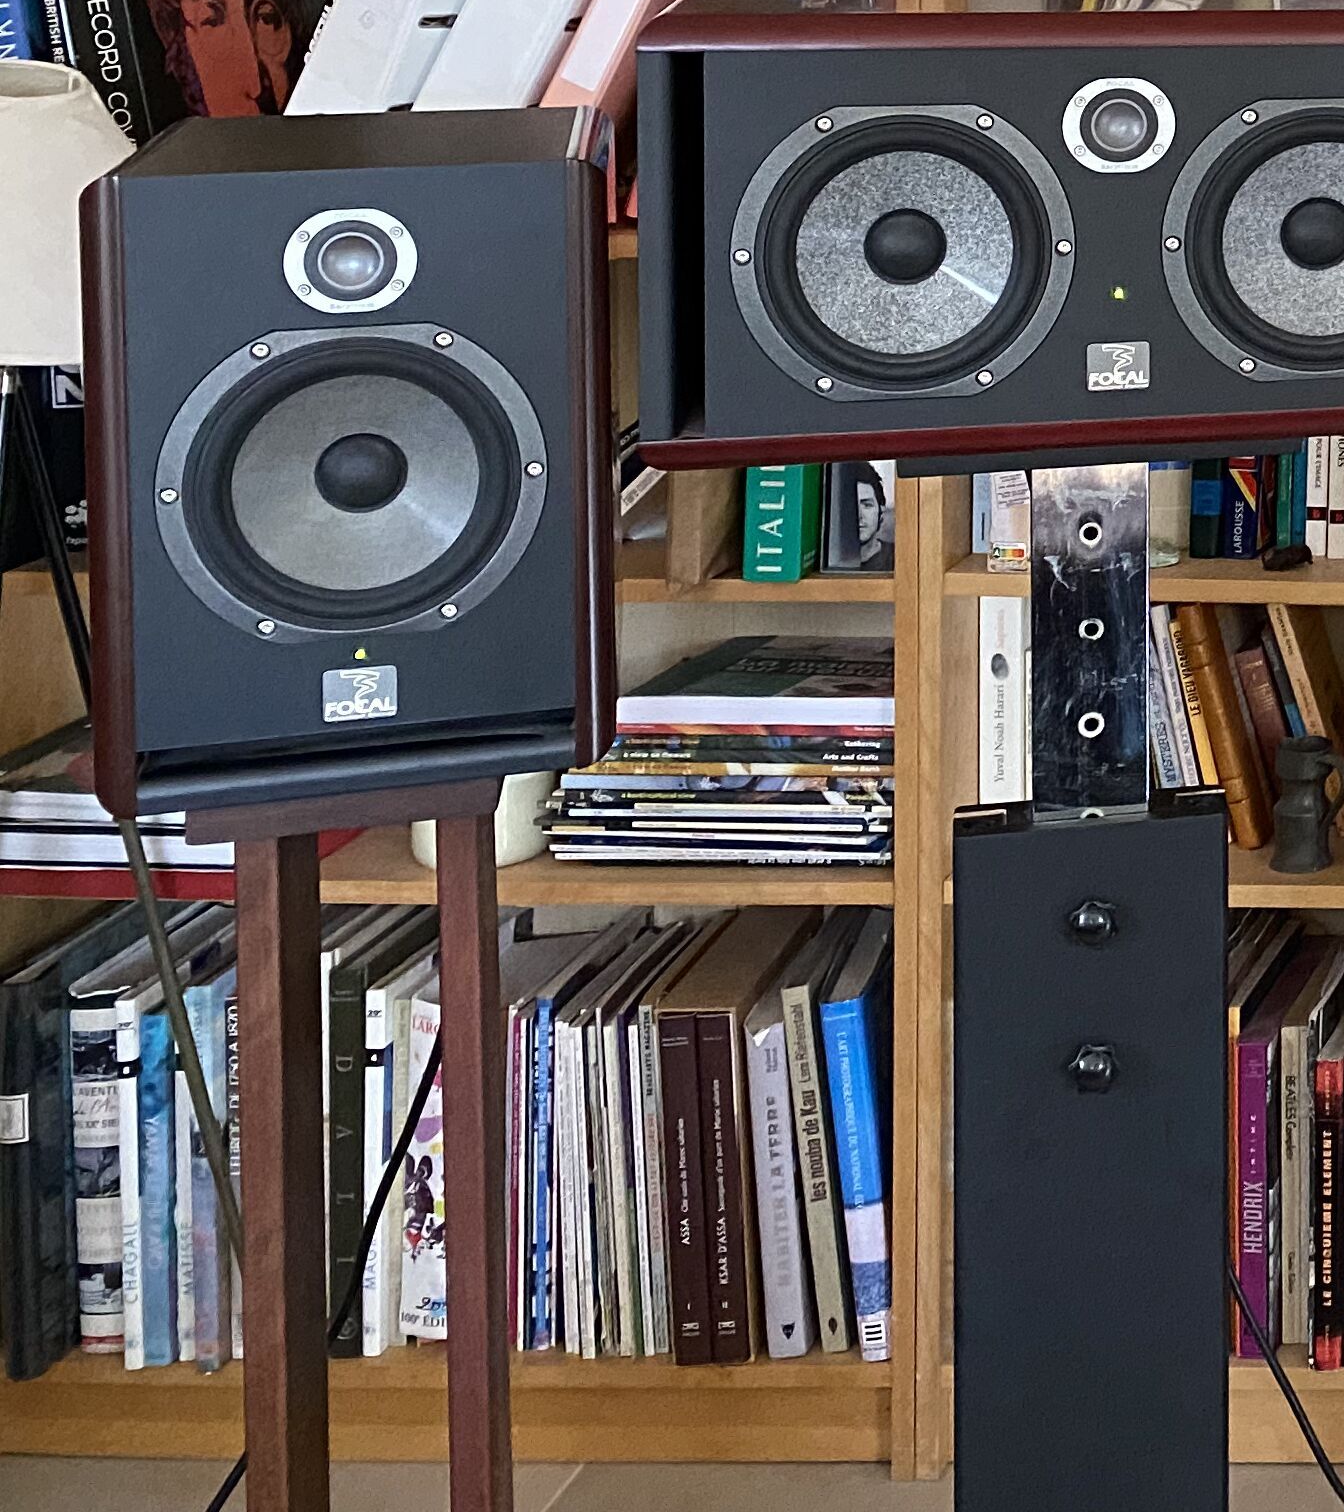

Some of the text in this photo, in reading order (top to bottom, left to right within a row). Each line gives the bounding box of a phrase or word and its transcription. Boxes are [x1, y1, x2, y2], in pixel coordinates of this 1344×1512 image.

[1089, 371, 1149, 386] FOCAL
[1232, 500, 1245, 553] LAROUSSE
[325, 697, 395, 717] FOCAL
[992, 684, 1006, 783] Yuval Noah Harari
[800, 1089, 828, 1202] les nouba de Kau
[679, 1218, 691, 1245] ASSA
[1243, 1181, 1264, 1254] HENDRIX
[1321, 1129, 1333, 1306] LE CINQUIEME ELEMENT
[122, 1221, 138, 1305] CHAGALL
[180, 1221, 194, 1296] MATISSE
